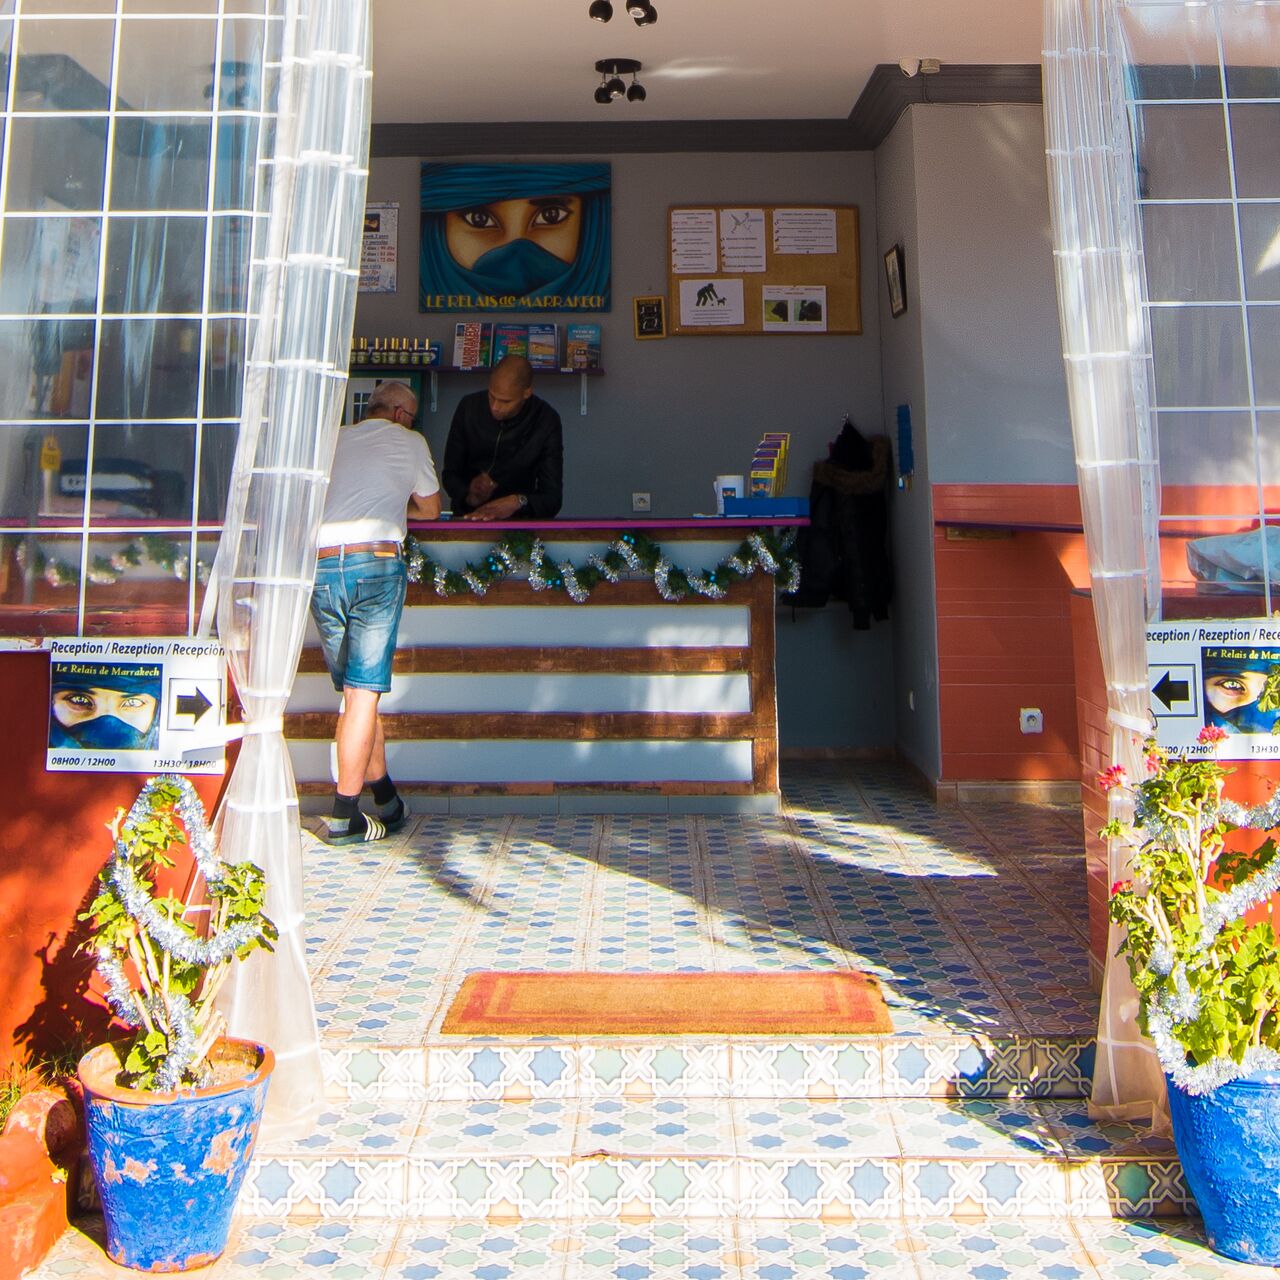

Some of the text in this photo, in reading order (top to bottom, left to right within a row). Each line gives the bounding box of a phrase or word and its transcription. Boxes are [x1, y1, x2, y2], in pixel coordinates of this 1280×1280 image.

[426, 295, 605, 308] LE RELAIS de MARRAKECH
[1145, 629, 1190, 644] eception
[1198, 628, 1250, 644] Rezeption
[51, 641, 103, 657] Reception
[111, 642, 164, 658] Rezeption
[172, 643, 225, 659] Recepción
[1206, 648, 1218, 658] Le
[1220, 649, 1247, 659] Relais
[1248, 650, 1259, 659] de
[56, 663, 161, 677] Le Relais de Marrakech
[1185, 745, 1214, 754] 12H00
[1250, 745, 1279, 754] 13H30
[51, 756, 80, 766] 08H00
[87, 757, 116, 767] 12H00
[153, 759, 182, 768] 13H30
